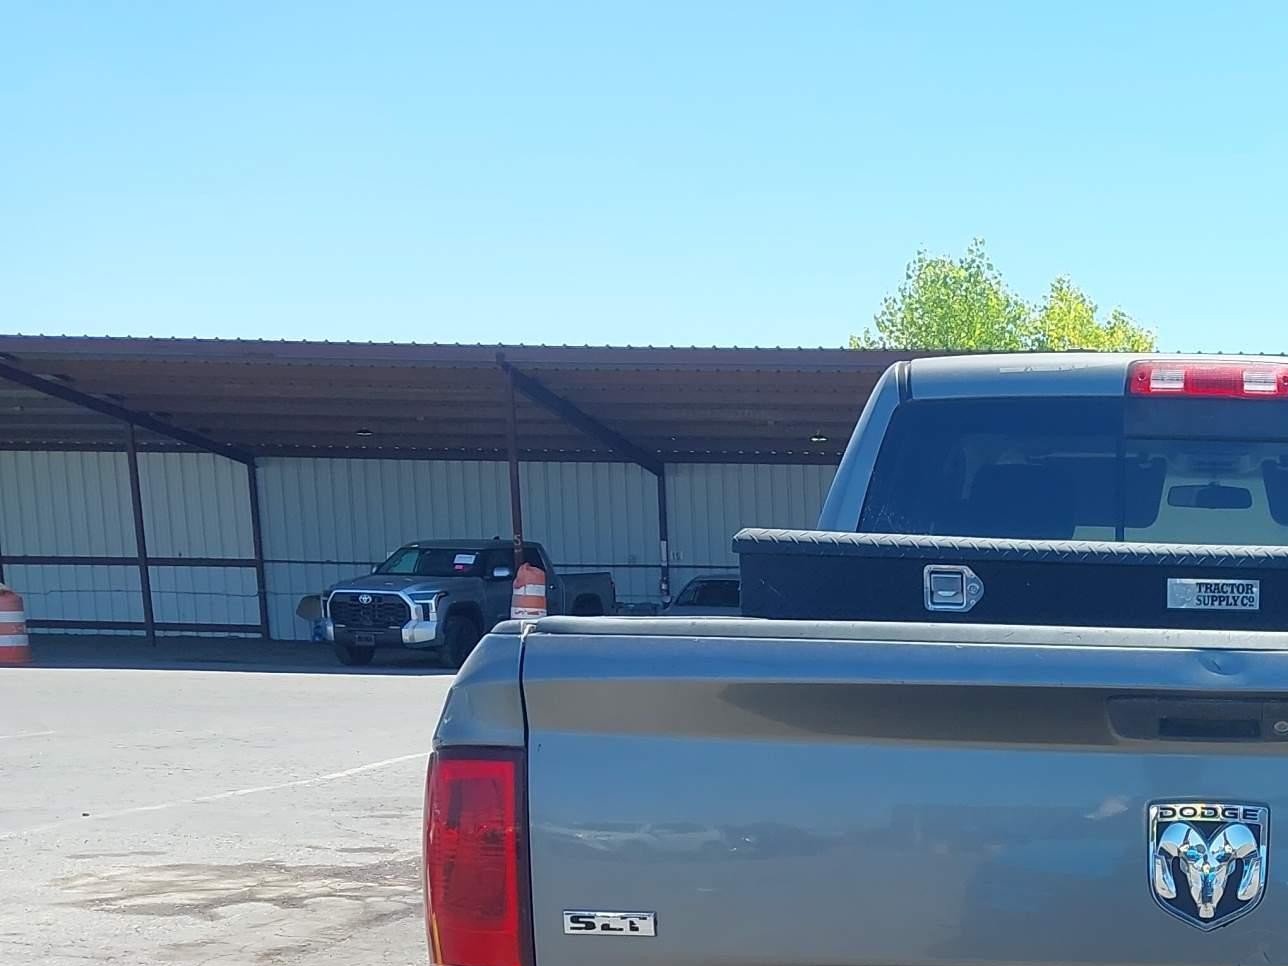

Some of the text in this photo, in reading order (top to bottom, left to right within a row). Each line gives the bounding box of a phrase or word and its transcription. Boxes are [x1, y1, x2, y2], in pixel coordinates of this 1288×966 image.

[1196, 582, 1254, 595] TRACTOR
[1196, 595, 1240, 606] SUPPLY
[1159, 806, 1259, 820] DODGE
